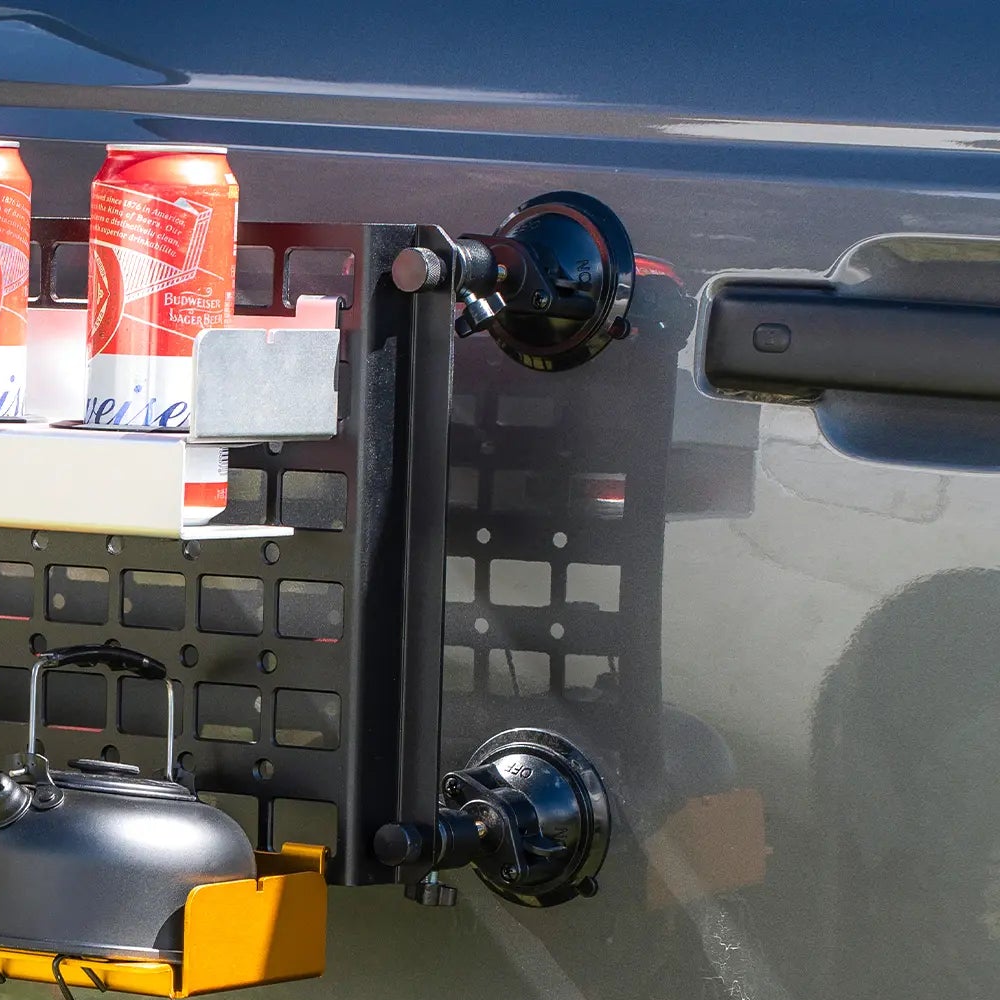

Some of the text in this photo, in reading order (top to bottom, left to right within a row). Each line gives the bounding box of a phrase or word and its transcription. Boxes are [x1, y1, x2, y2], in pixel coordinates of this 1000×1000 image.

[3, 207, 11, 215] of
[106, 195, 121, 204] since
[123, 200, 142, 211] 1876
[142, 204, 151, 214] in
[152, 208, 186, 227] America,
[107, 205, 123, 216] King
[125, 211, 135, 220] of
[136, 213, 162, 229] Beers.
[165, 224, 182, 235] Our
[100, 227, 127, 239] superior
[110, 217, 156, 236] distinctively
[156, 231, 180, 247] clean,
[164, 292, 221, 309] BUDWEISER
[169, 308, 223, 326] LAGER BEER
[504, 762, 533, 779] OFF
